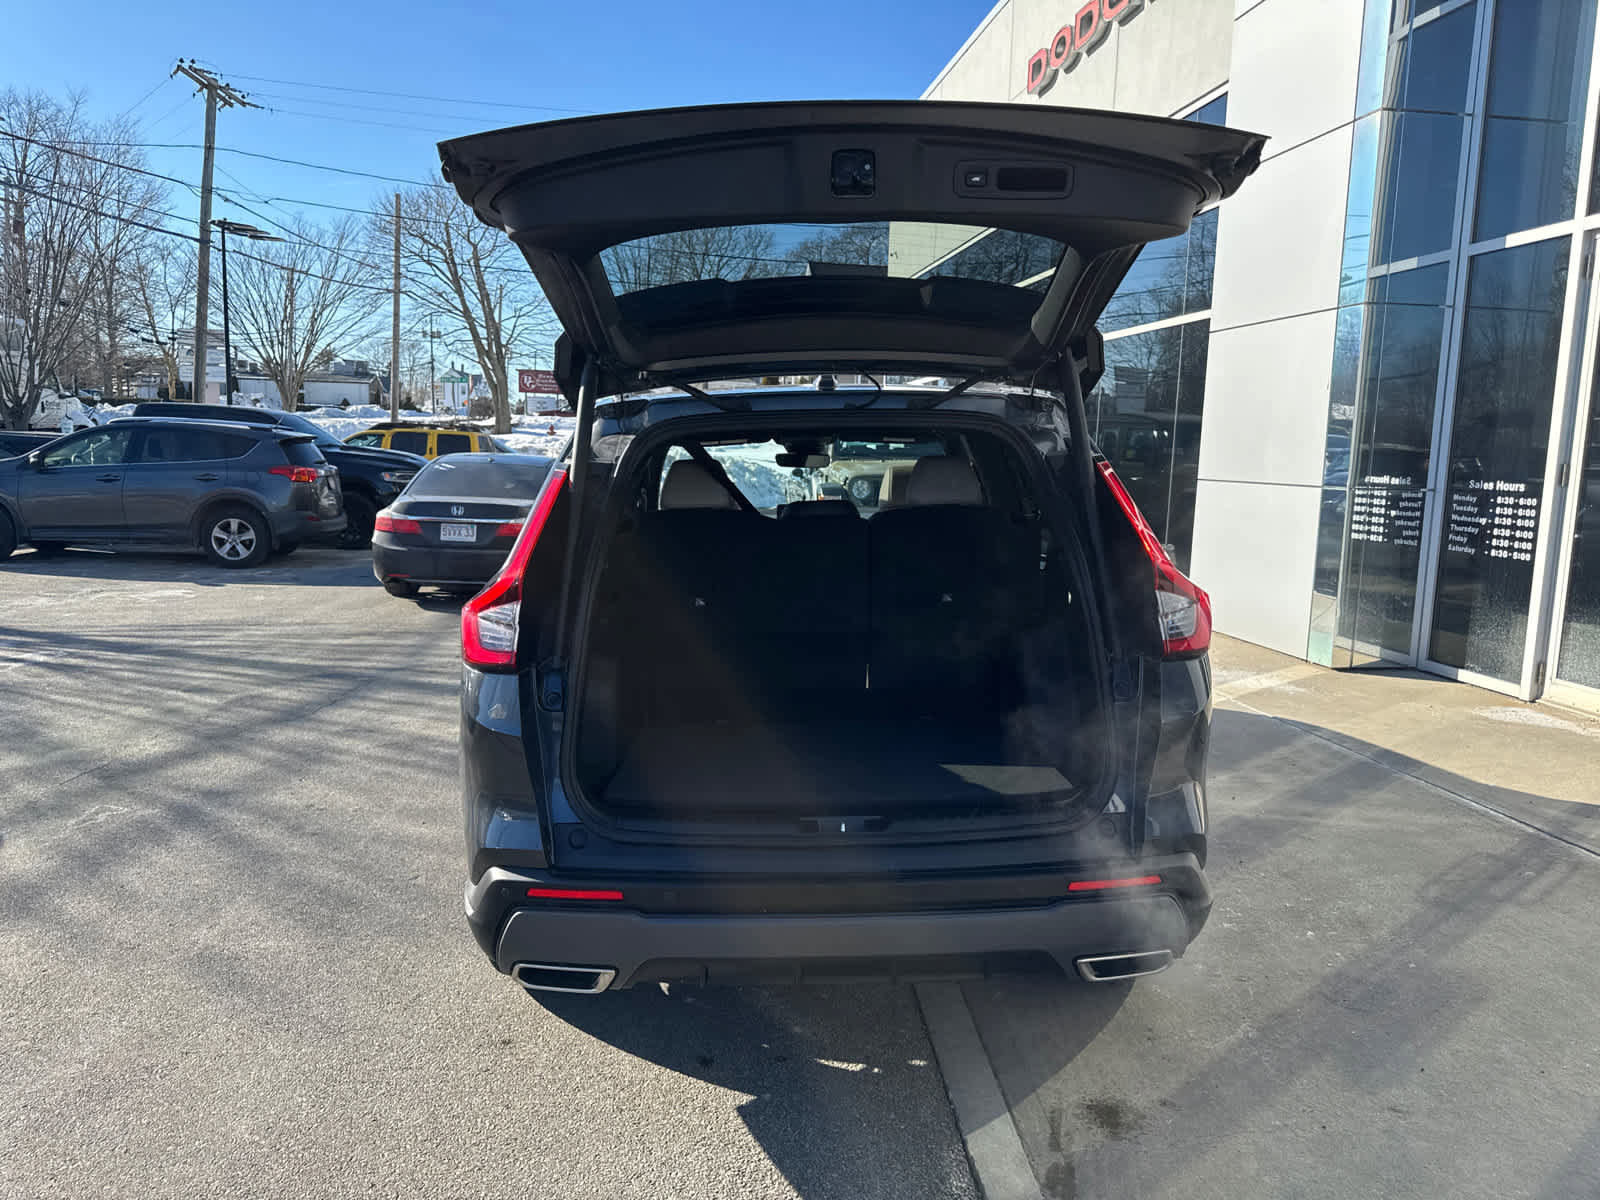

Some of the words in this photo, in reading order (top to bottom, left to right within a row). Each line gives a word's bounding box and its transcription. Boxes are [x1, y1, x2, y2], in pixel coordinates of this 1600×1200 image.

[1469, 480, 1494, 490] Sales
[1496, 481, 1525, 492] Hours
[1453, 494, 1478, 503] Monday
[1452, 504, 1478, 513] Tuesday
[1451, 514, 1488, 525] Wednesday
[1450, 524, 1479, 534] Thursday
[1448, 534, 1468, 543] Friday
[1447, 544, 1475, 554] Saturday
